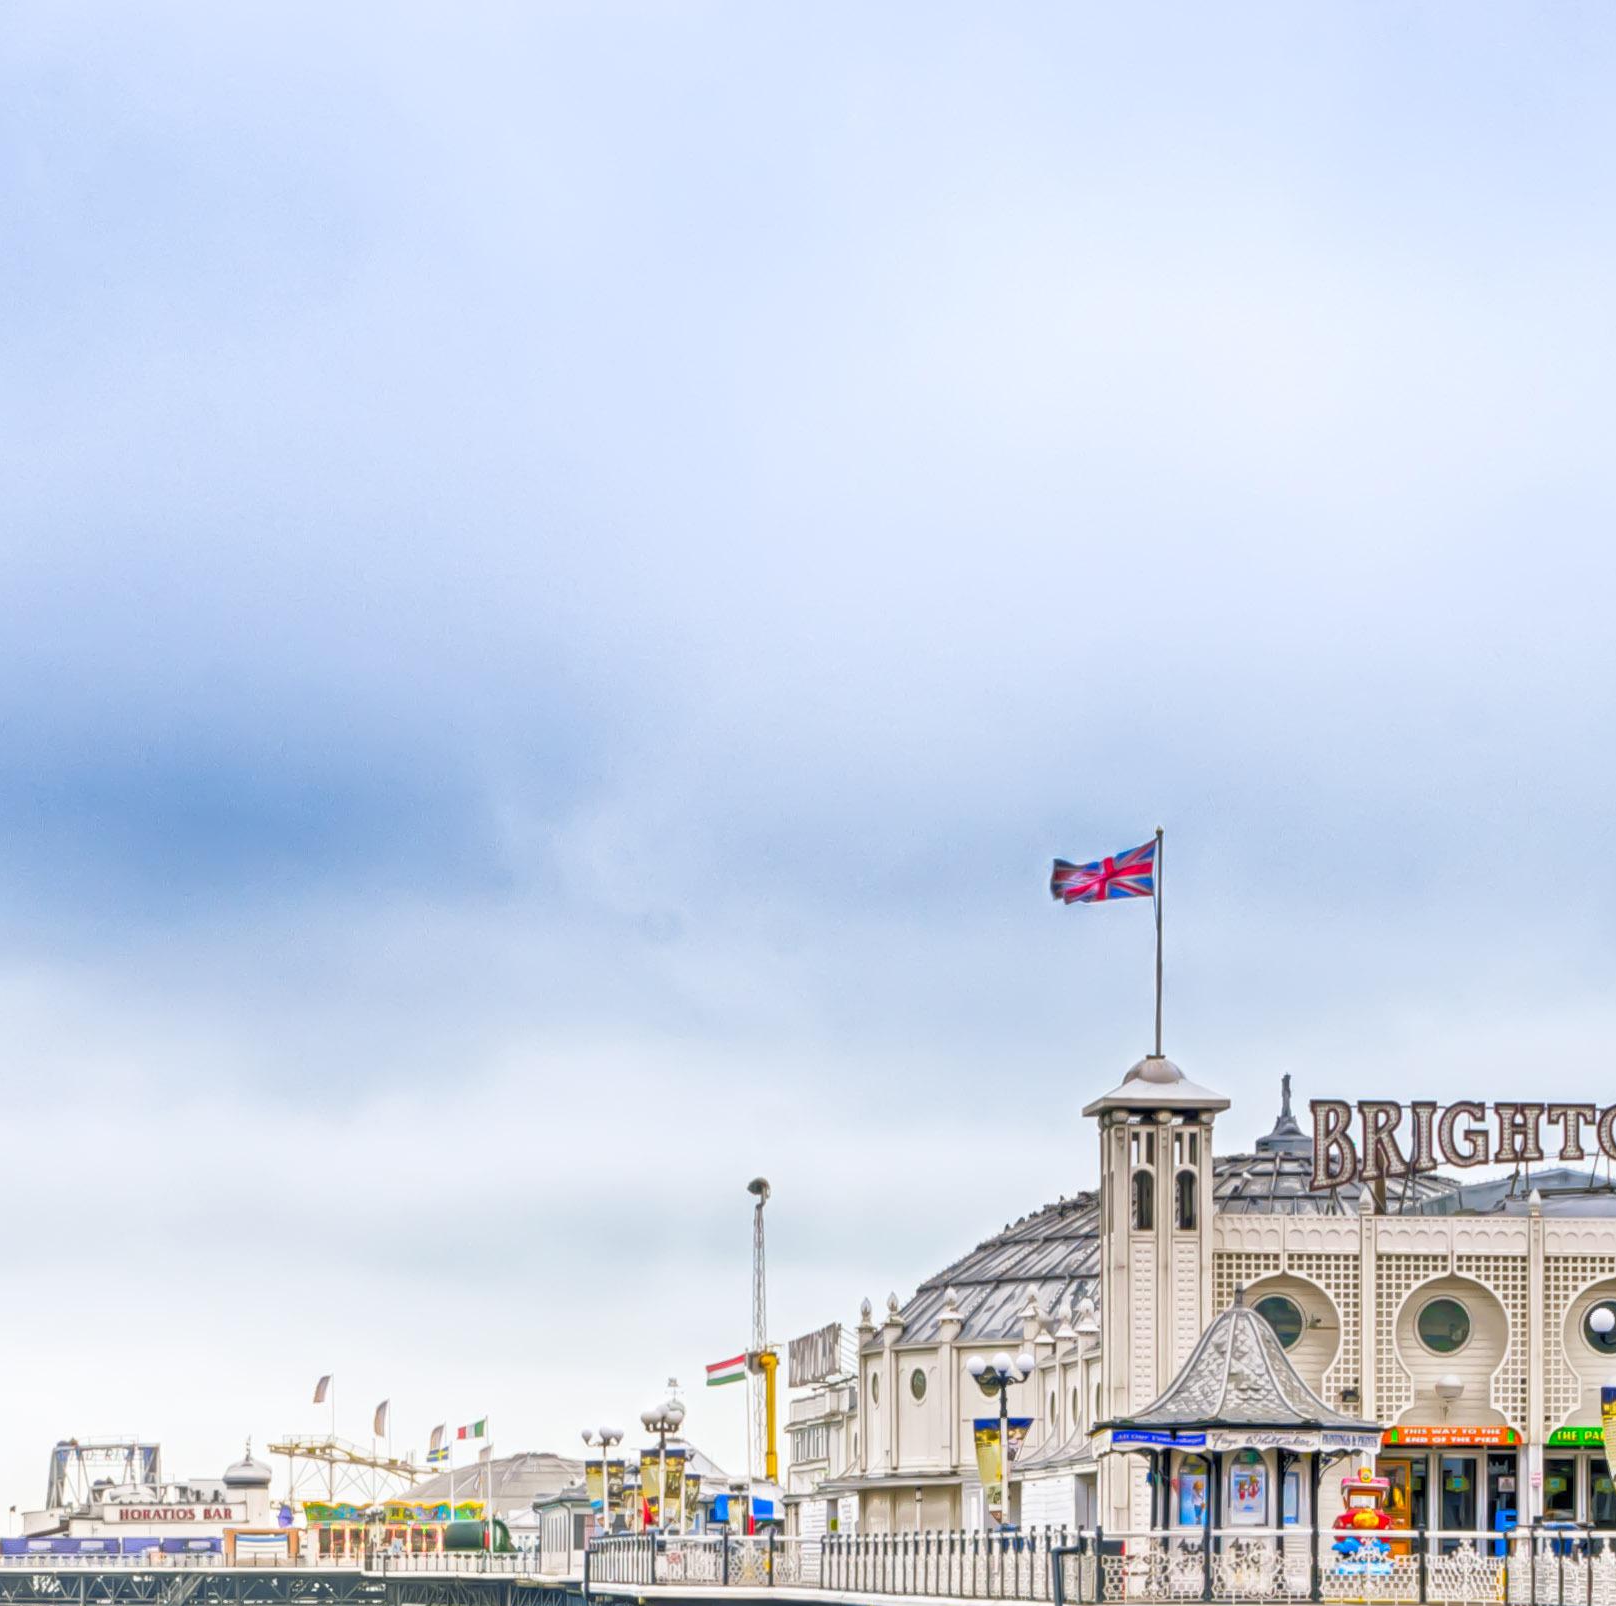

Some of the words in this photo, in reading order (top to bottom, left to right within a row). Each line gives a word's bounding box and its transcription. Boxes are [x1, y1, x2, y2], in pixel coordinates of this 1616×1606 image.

[1557, 1430, 1578, 1441] THE
[119, 1508, 196, 1520] HORATIOS
[203, 1508, 232, 1520] BAR
